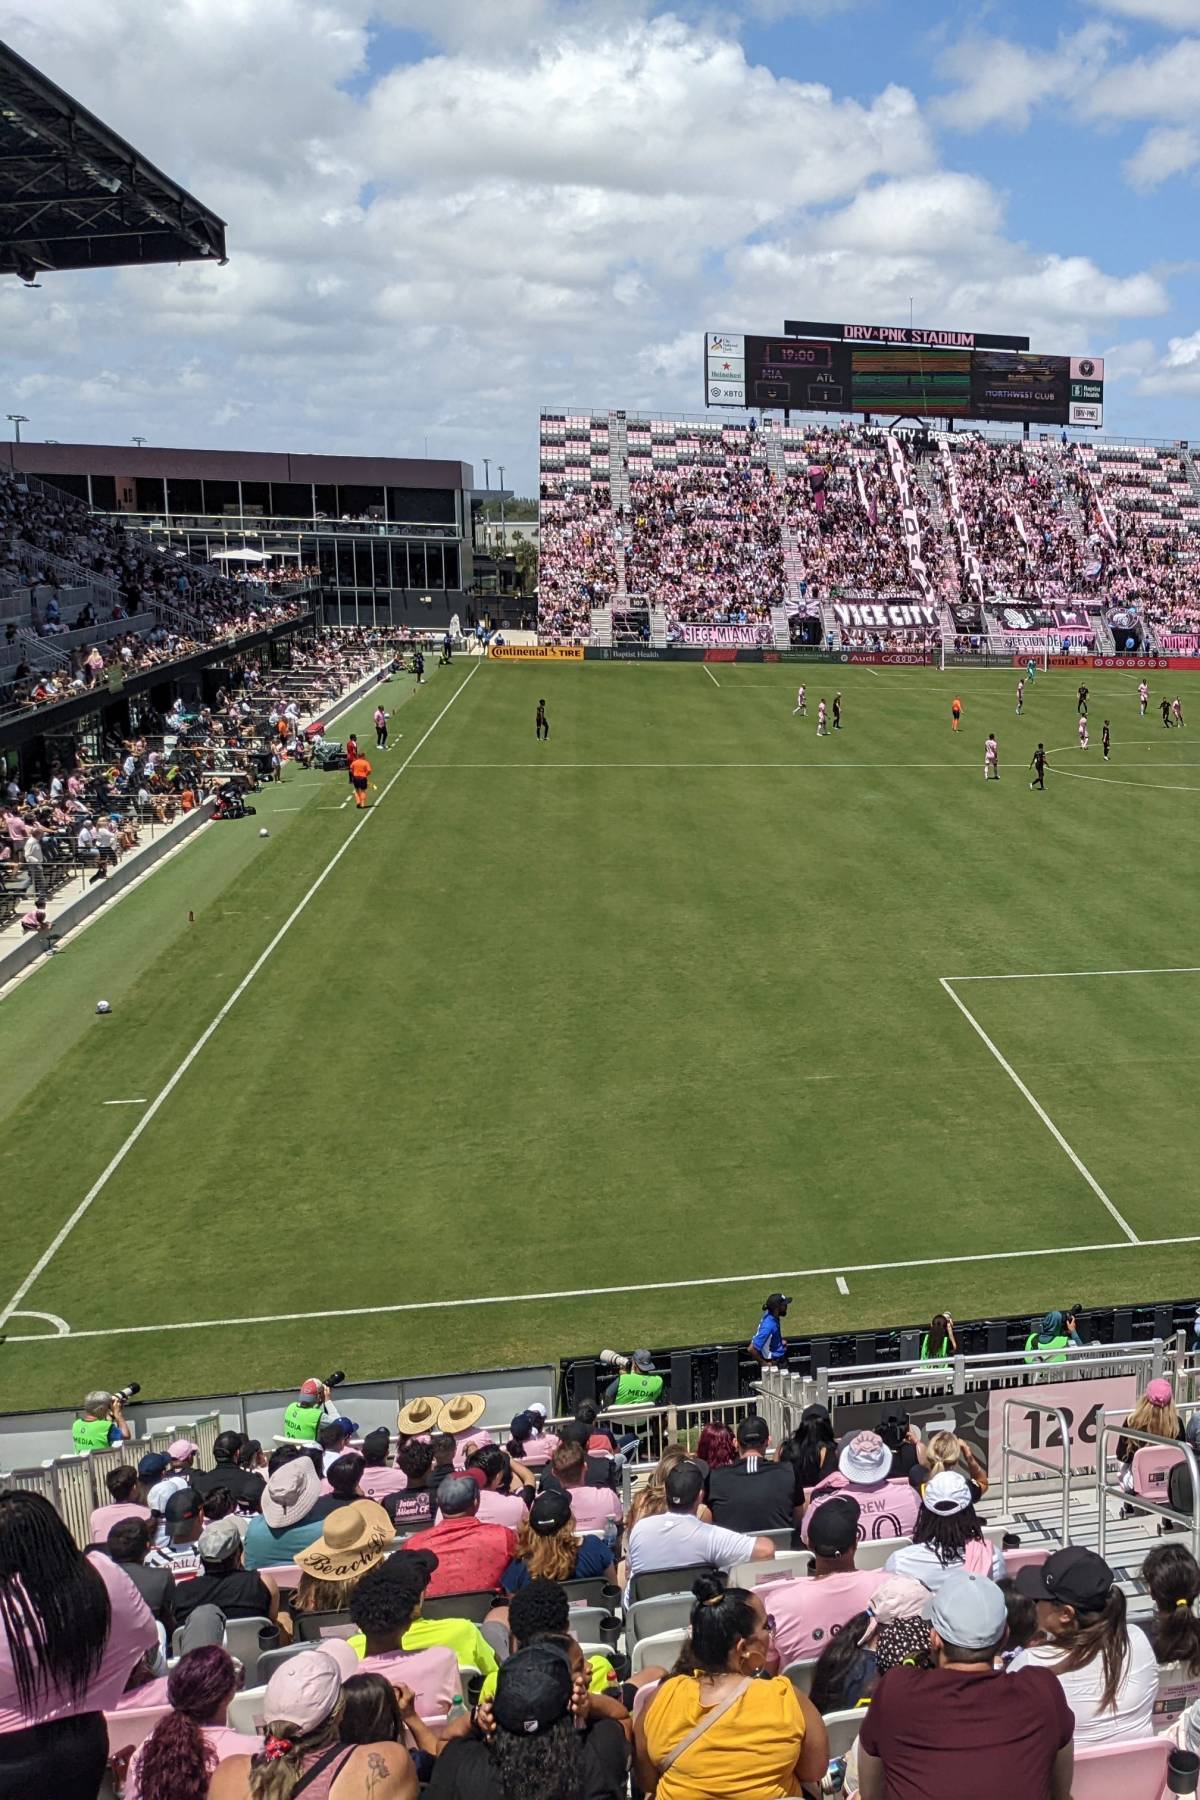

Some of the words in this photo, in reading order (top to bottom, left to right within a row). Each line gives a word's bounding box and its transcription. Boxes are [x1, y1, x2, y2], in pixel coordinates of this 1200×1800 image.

[911, 330, 975, 346] STADIUM
[781, 348, 815, 361] 19:00
[816, 373, 835, 383] ATL
[1034, 392, 1055, 401] CLUB
[865, 427, 890, 437] VICE
[889, 428, 916, 441] CITY
[927, 430, 975, 444] PRESENTE
[834, 603, 889, 627] VICE
[888, 604, 934, 626] CITY
[685, 626, 713, 642] SIEGE
[717, 627, 755, 643] MIAMI
[1158, 636, 1199, 649] SOUTHERN
[491, 646, 548, 658] Continental
[627, 1389, 654, 1397] MEDIA
[284, 1419, 302, 1432] MEDIA
[1023, 1403, 1104, 1450] 126
[73, 1436, 94, 1446] MEDIA
[399, 1499, 417, 1507] Inter
[419, 1505, 430, 1513] CF
[859, 1499, 886, 1515] REW
[303, 1551, 376, 1576] Beach
